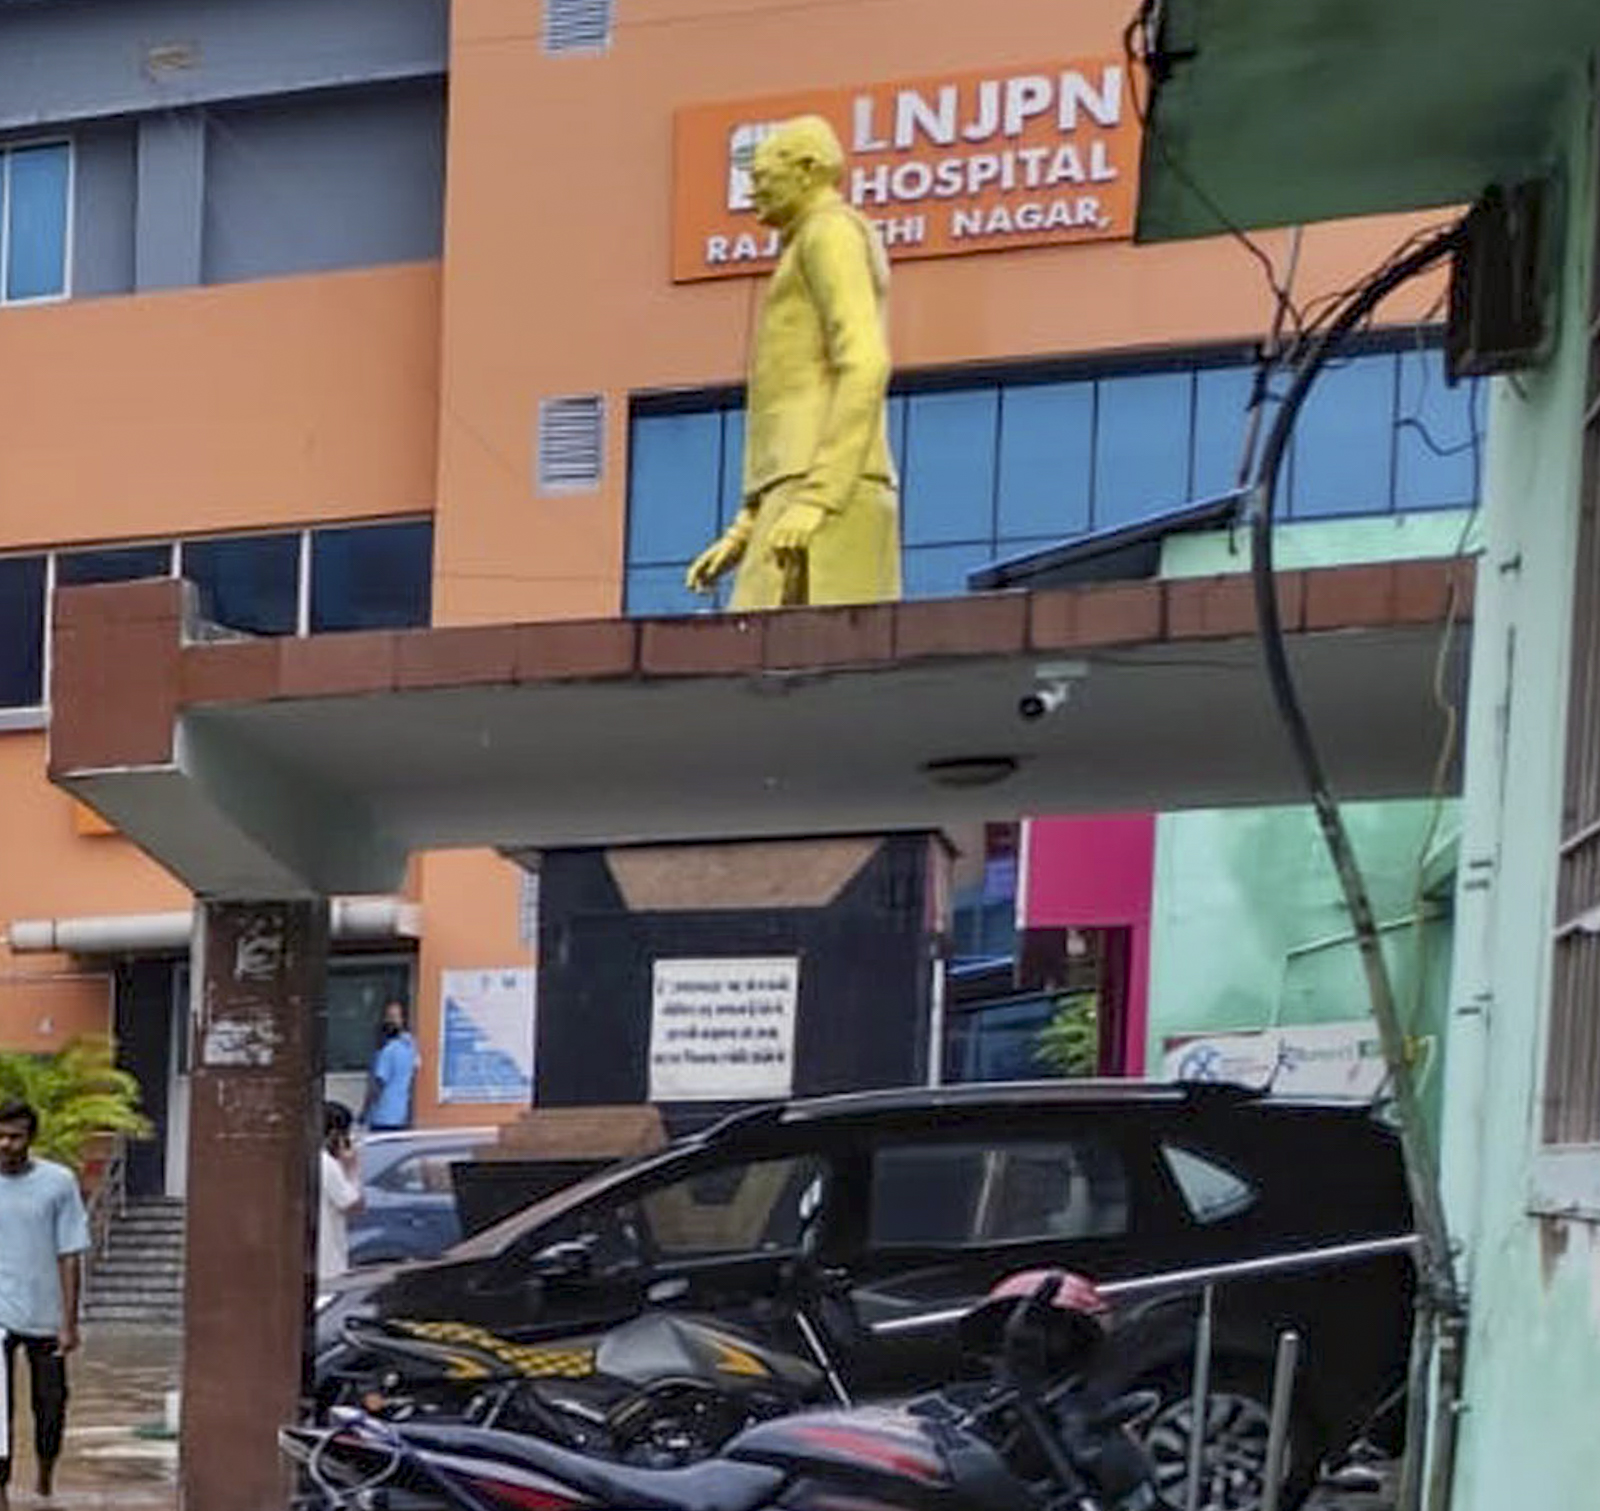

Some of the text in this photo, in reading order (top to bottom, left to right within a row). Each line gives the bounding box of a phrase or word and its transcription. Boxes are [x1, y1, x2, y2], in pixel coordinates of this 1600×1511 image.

[852, 66, 1123, 152] LNJPN
[851, 140, 1118, 205] HOSPITAL
[952, 196, 1112, 238] NAGAR,
